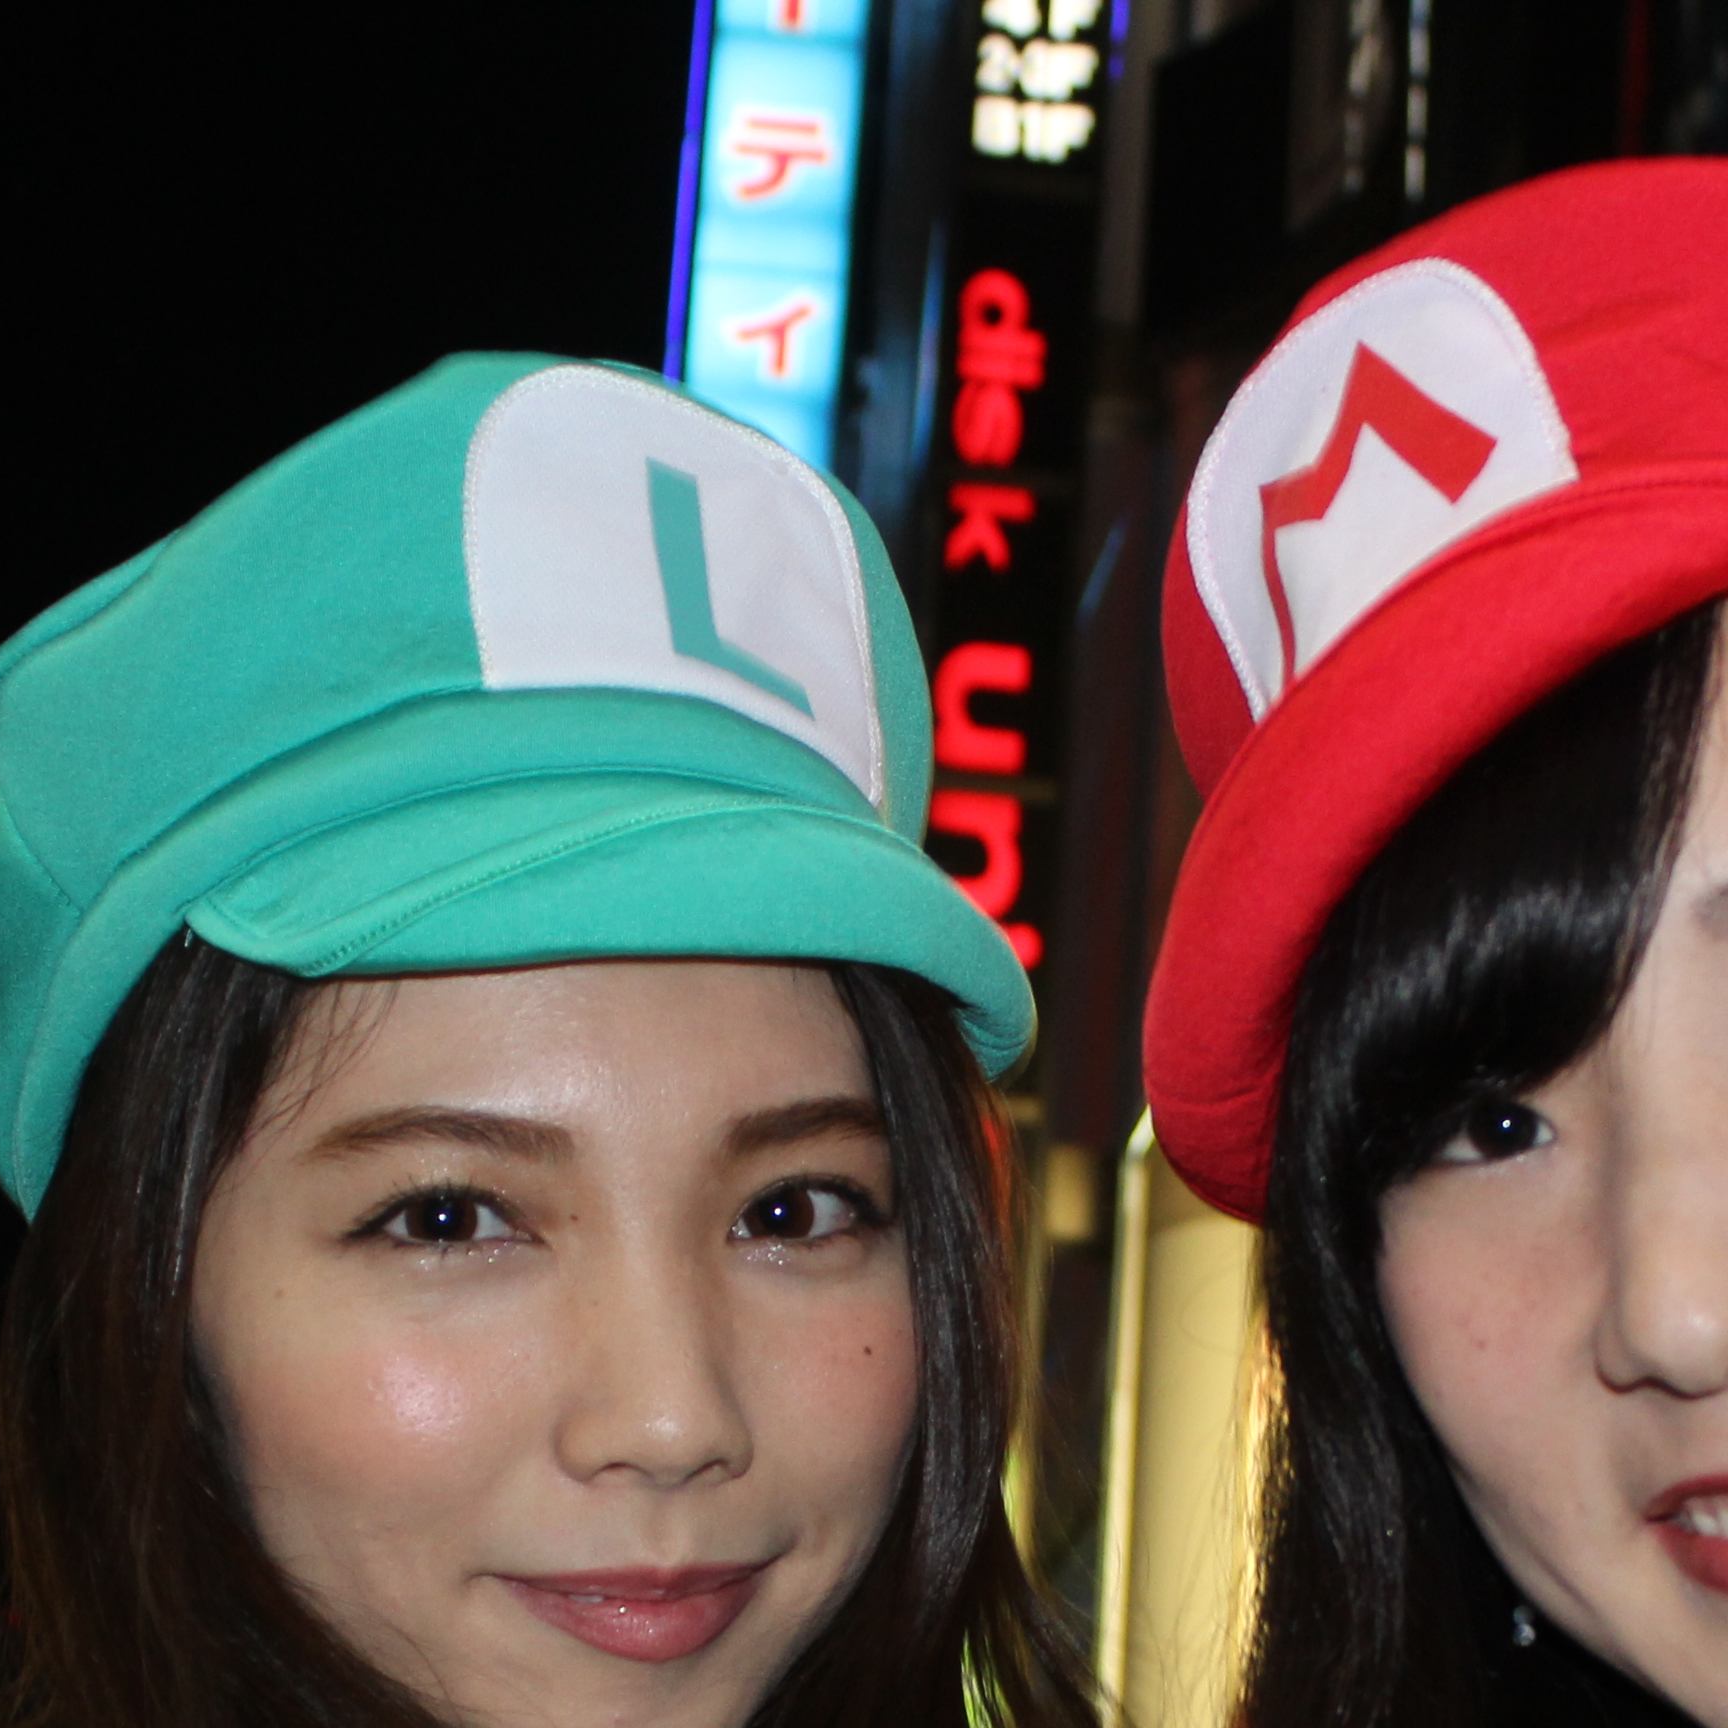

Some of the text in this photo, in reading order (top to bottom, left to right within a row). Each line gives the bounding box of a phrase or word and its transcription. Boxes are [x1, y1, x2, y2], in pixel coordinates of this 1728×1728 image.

[943, 267, 1048, 573] disk
[1258, 340, 1498, 695] M
[646, 456, 816, 722] L
